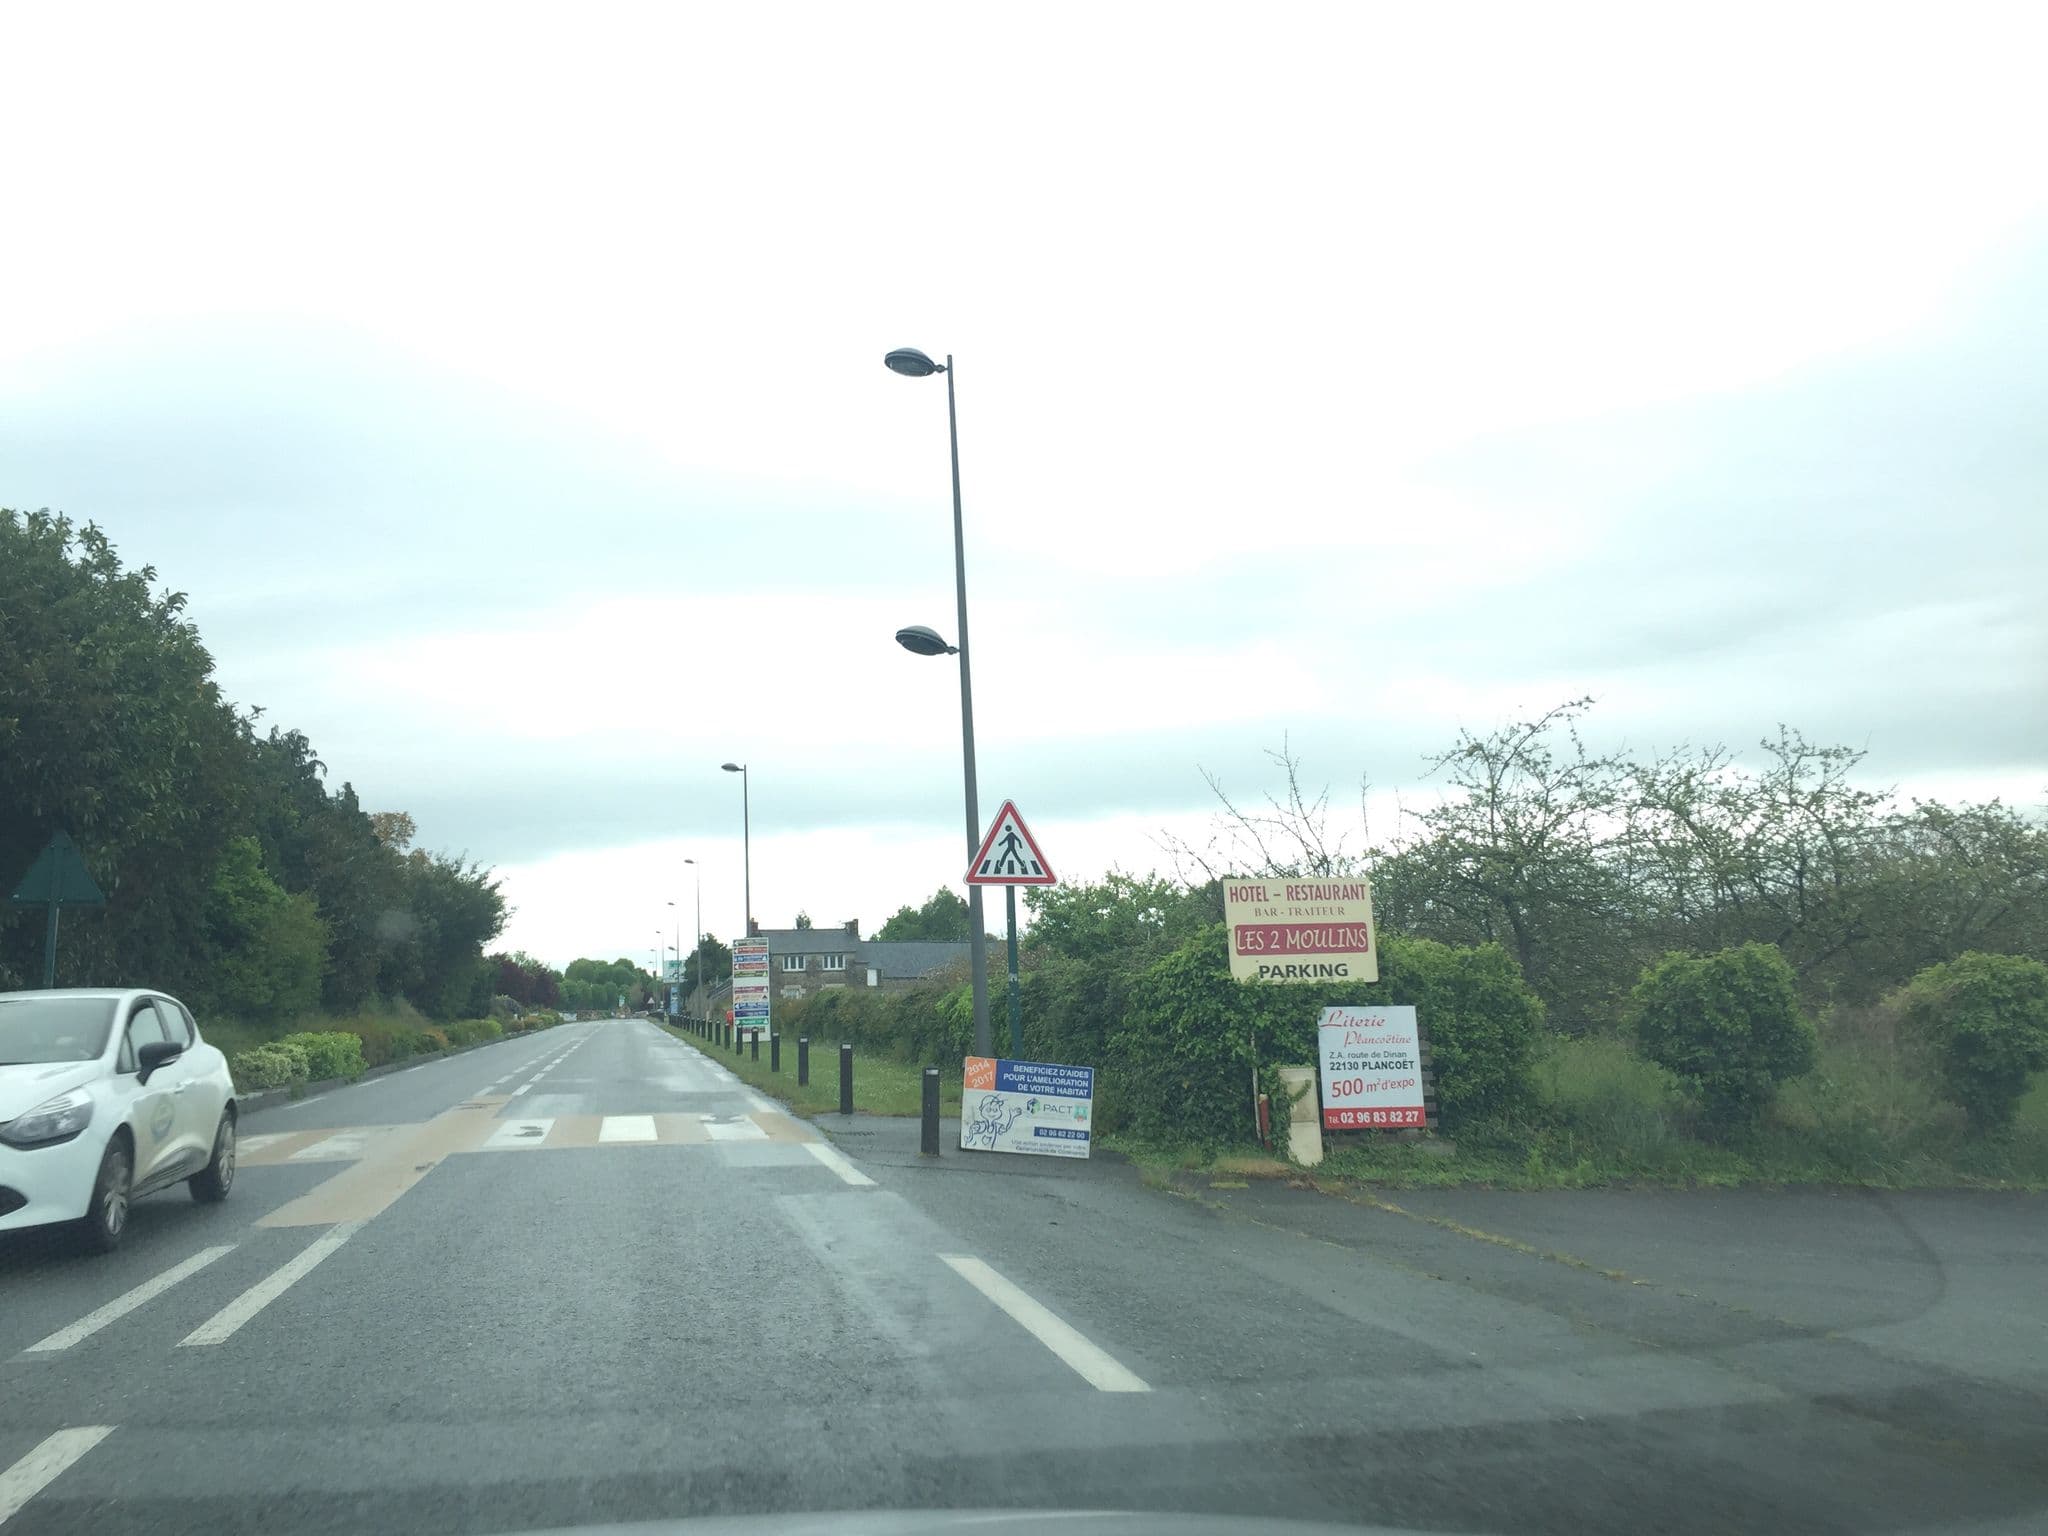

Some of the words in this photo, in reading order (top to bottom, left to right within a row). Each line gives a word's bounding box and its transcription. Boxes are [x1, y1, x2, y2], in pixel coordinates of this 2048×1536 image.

[1229, 886, 1269, 903] HOTEL
[1286, 884, 1366, 901] RESTAURANT
[1255, 907, 1278, 917] BAR
[1288, 906, 1345, 916] TRAITEUR
[1236, 930, 1264, 950] LES
[1270, 930, 1280, 949] 2
[1286, 928, 1367, 949] MOULINS
[1259, 963, 1348, 979] PARKING
[1320, 1010, 1385, 1027] Literie
[1371, 1051, 1381, 1059] de
[1383, 1050, 1407, 1059] Dinan
[967, 1060, 990, 1076] 2014
[1013, 1065, 1058, 1076] BENEFICIEZ
[1060, 1069, 1089, 1079] D'AIDES
[1329, 1061, 1359, 1071] 22130
[972, 1071, 993, 1088] 2017
[1003, 1073, 1025, 1081] POUR
[1027, 1075, 1089, 1087] L'AMELIORATION
[1017, 1083, 1029, 1091] DE
[1029, 1084, 1055, 1094] VOTRE
[1056, 1087, 1088, 1096] HABITAT
[1331, 1078, 1363, 1098] 500
[1381, 1078, 1415, 1091] d'expo
[1043, 1103, 1073, 1114] PACT
[1340, 1112, 1354, 1124] 02
[1357, 1112, 1371, 1123] 96
[1373, 1112, 1386, 1123] 83
[1389, 1111, 1403, 1123] 82
[1405, 1111, 1419, 1123] 27
